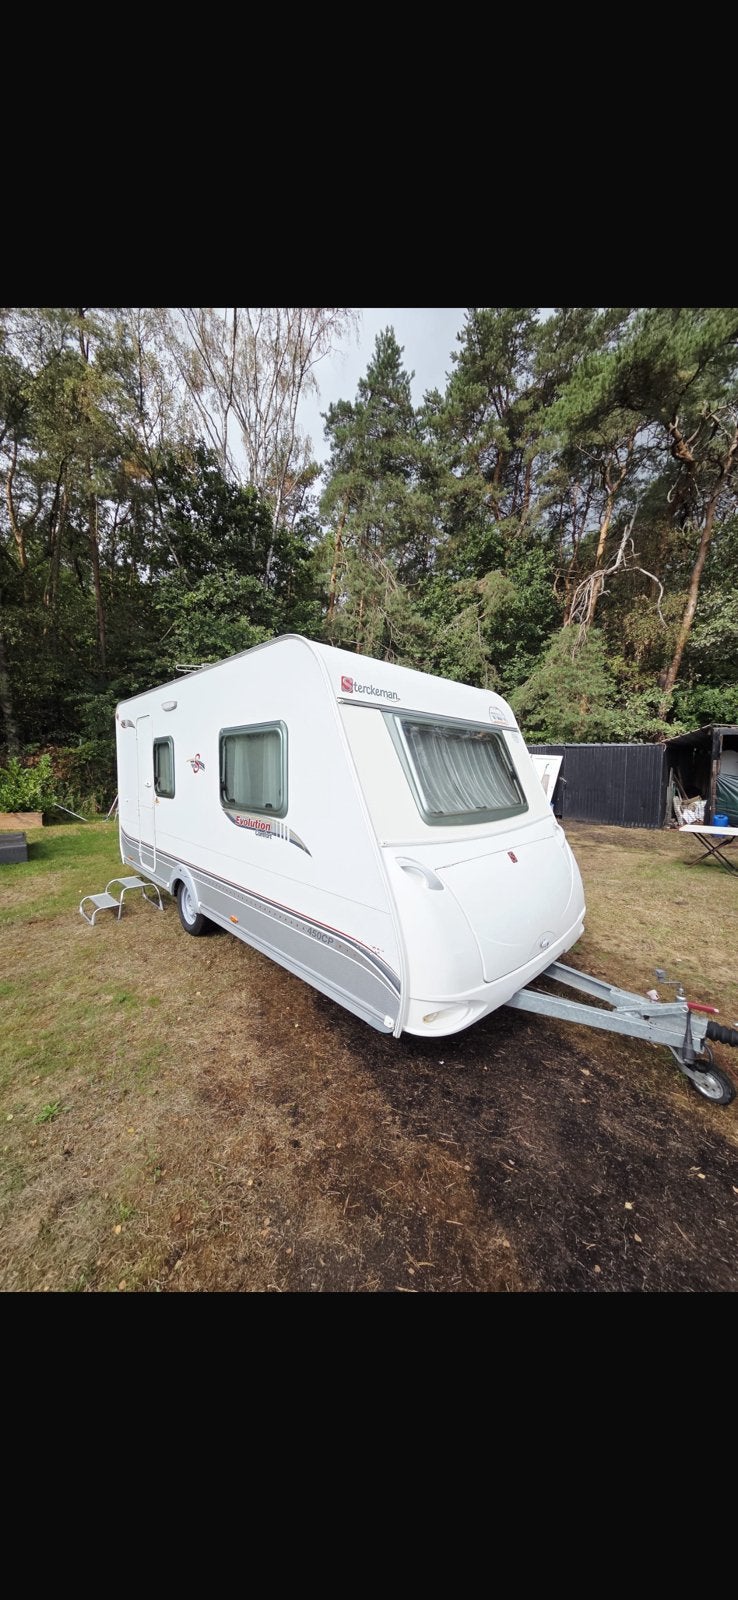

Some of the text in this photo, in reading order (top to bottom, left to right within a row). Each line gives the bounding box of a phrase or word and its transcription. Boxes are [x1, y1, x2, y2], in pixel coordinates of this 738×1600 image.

[341, 676, 398, 700] Sterckeman
[235, 816, 271, 831] Evolution
[306, 927, 334, 944] 450CP
